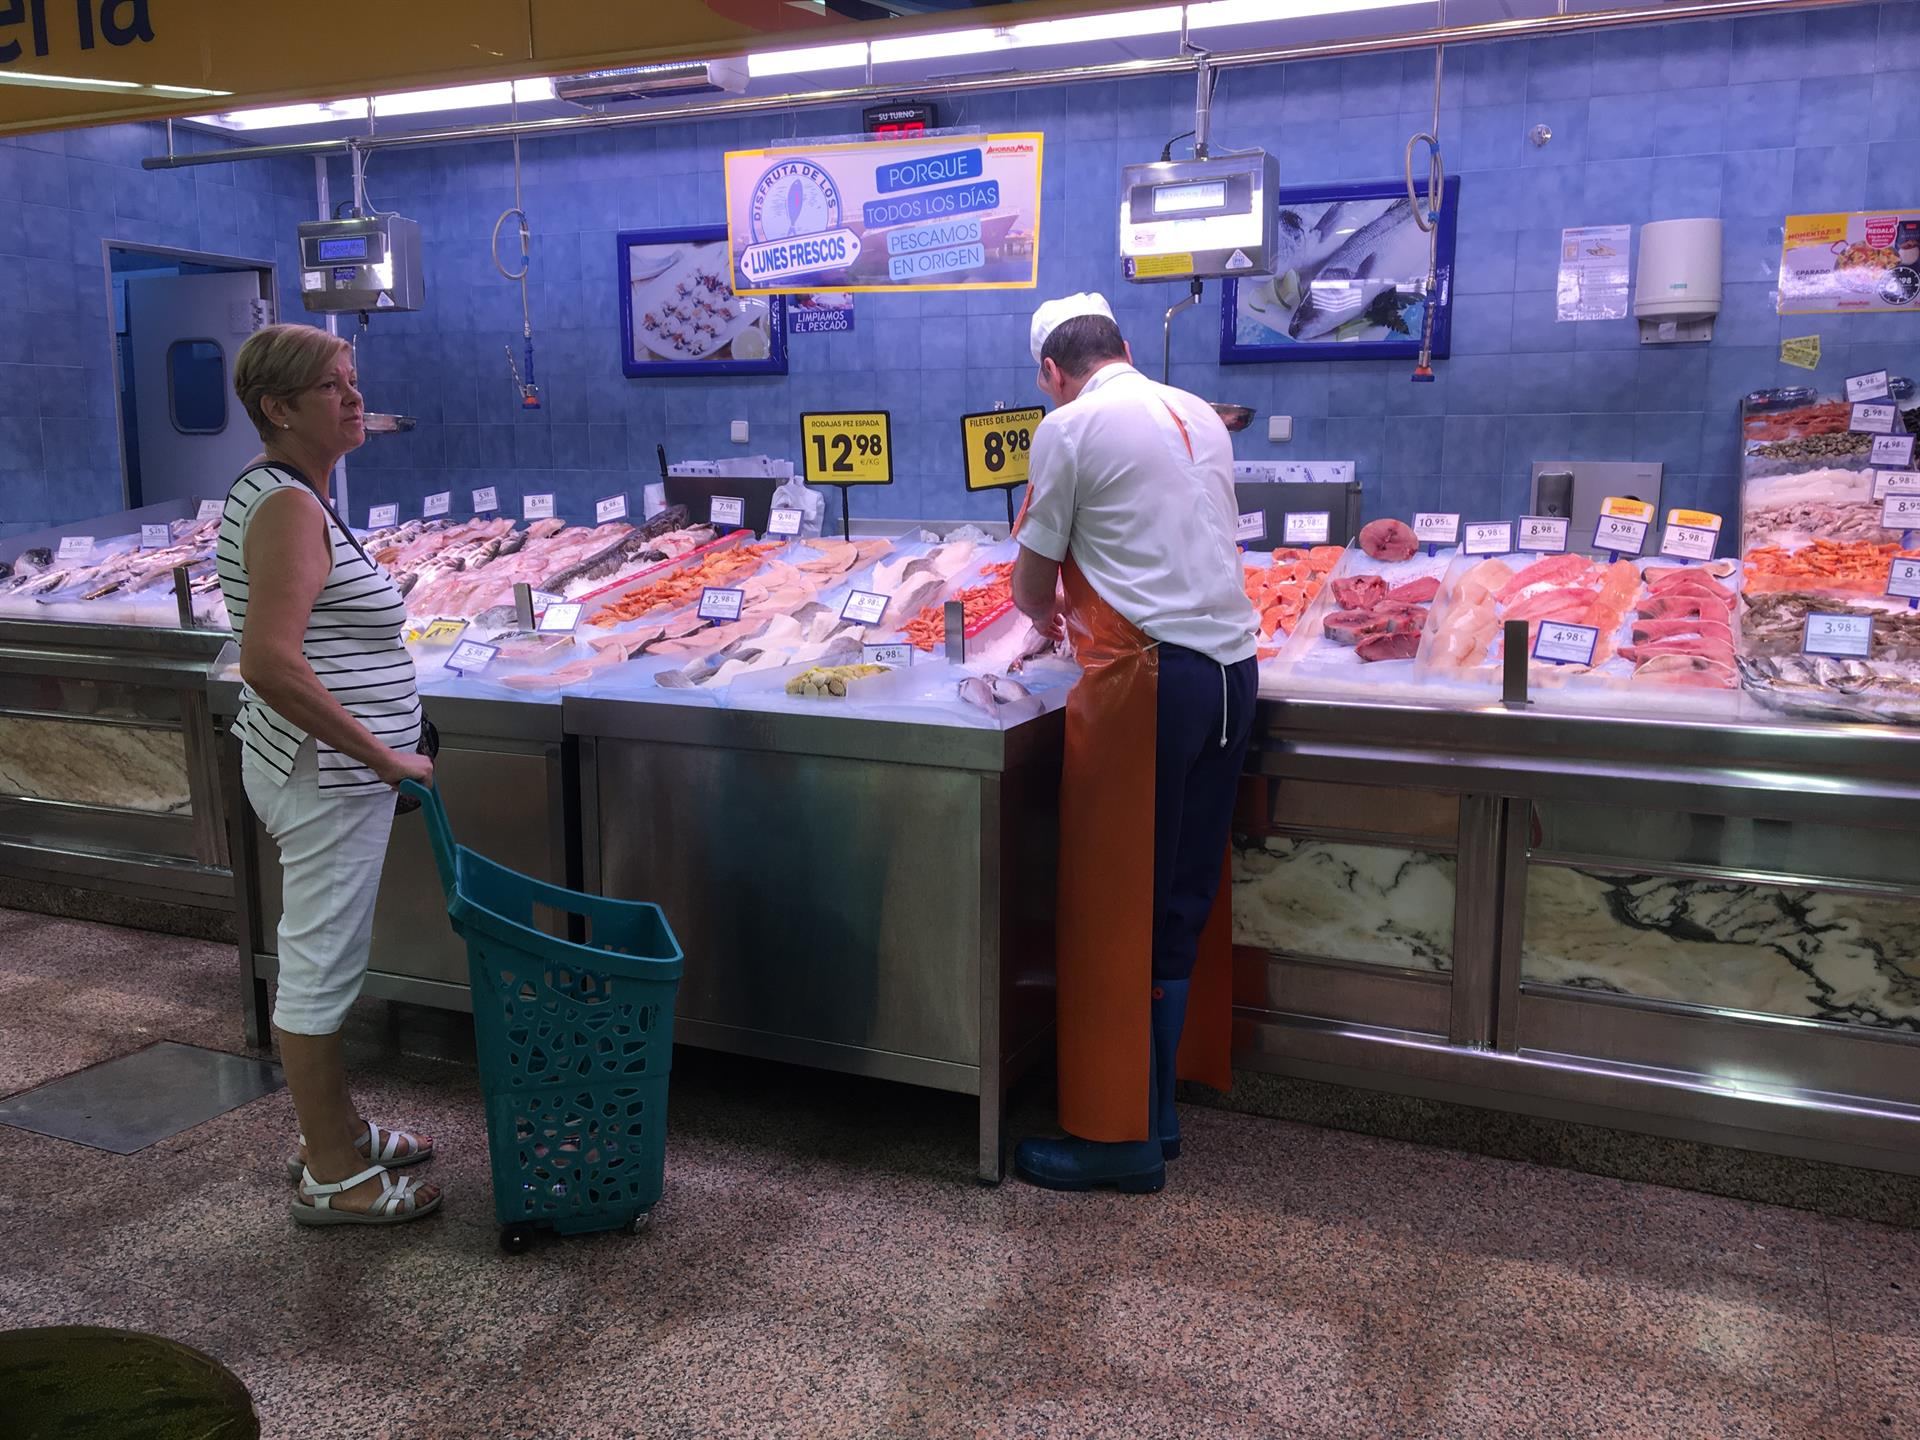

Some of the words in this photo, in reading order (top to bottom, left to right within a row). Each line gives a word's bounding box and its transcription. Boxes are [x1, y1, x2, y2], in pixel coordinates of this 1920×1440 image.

[879, 112, 888, 120] SU
[890, 110, 915, 119] TURNO
[889, 155, 968, 187] PORQUE
[754, 165, 798, 221] DISFRUTA
[801, 166, 819, 181] DE
[819, 179, 836, 209] LOS
[866, 201, 921, 224] TODOS
[925, 195, 955, 215] LOS
[959, 186, 997, 208] DÍAS
[891, 223, 978, 251] PESCAMOS
[751, 246, 789, 275] LUNES
[790, 236, 846, 267] FRESCOS
[894, 259, 914, 276] EN
[918, 247, 979, 272] ORIGEN
[795, 322, 806, 332] EL
[808, 320, 848, 332] PESCADO
[797, 310, 844, 323] LIMPIAMOS
[969, 418, 994, 428] FILETES
[995, 416, 1005, 424] DE
[1006, 412, 1039, 423] BACALAO
